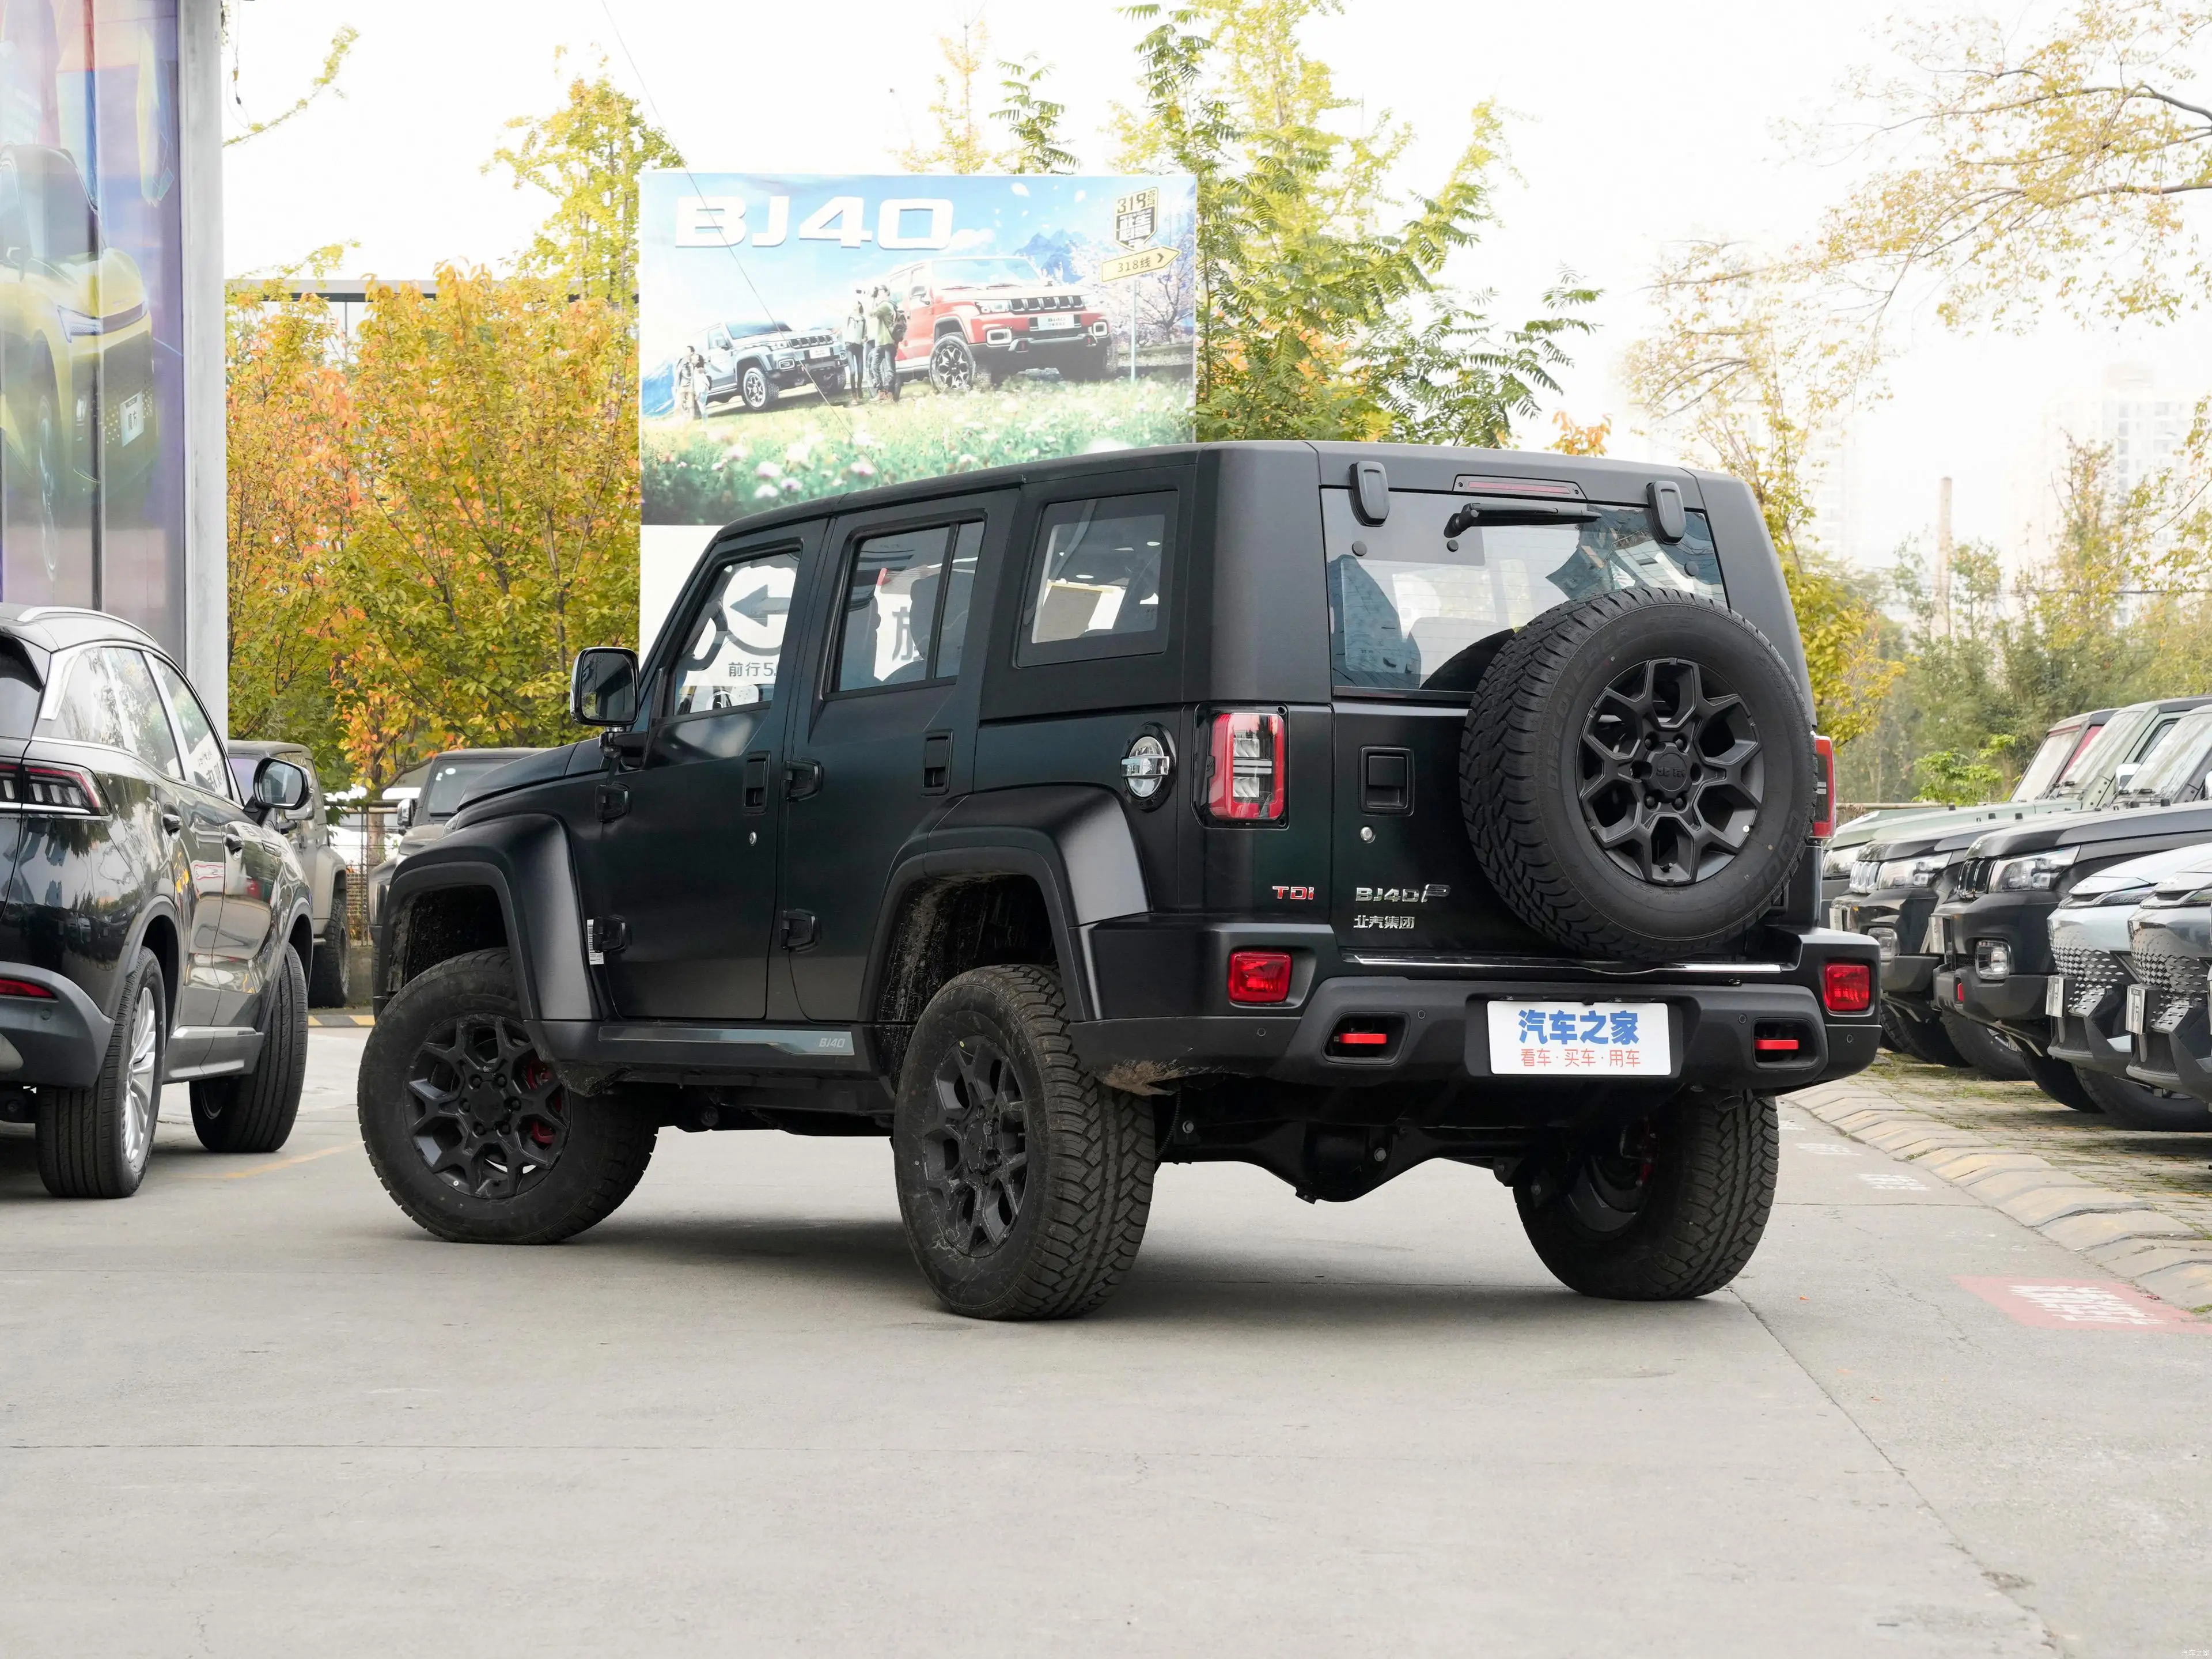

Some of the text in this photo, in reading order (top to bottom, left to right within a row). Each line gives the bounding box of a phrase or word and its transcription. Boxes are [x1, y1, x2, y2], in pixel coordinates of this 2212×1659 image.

[675, 196, 953, 250] BJ40
[1118, 256, 1151, 272] 318线
[728, 662, 777, 677] 前行5
[1353, 915, 1415, 929] 北汽集团
[1518, 1009, 1639, 1045] 汽车之家
[819, 1037, 846, 1048] BJ40
